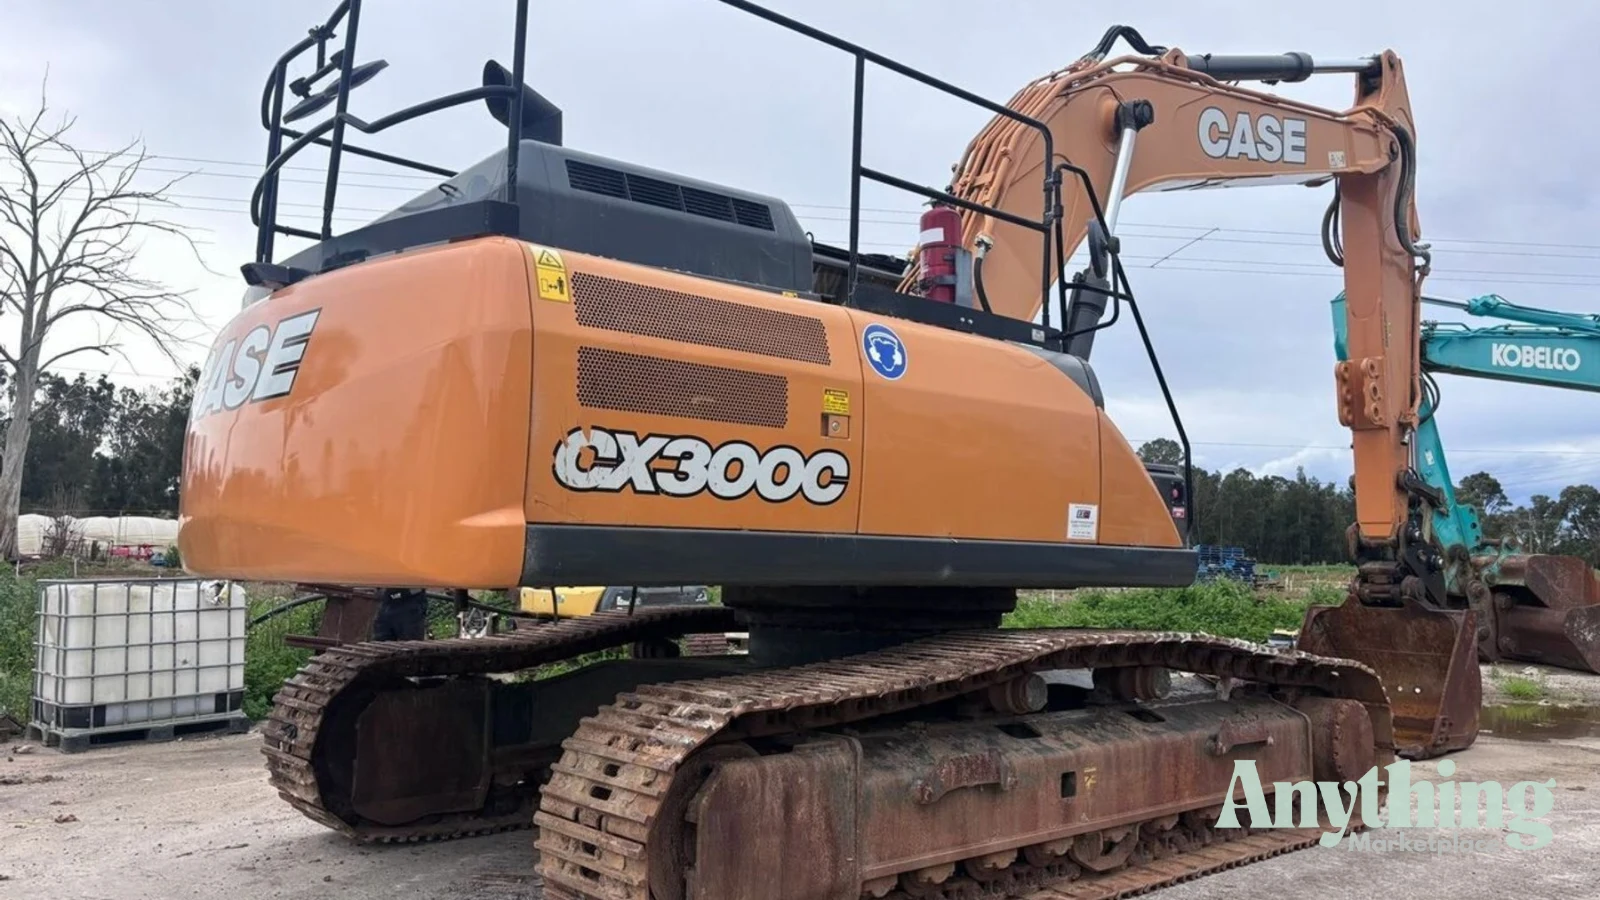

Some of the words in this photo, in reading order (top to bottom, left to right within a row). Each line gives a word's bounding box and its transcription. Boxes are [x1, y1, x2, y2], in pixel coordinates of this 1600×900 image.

[1198, 106, 1306, 164] CASE
[1491, 343, 1581, 371] KOBELCO
[552, 425, 850, 506] CX300C
